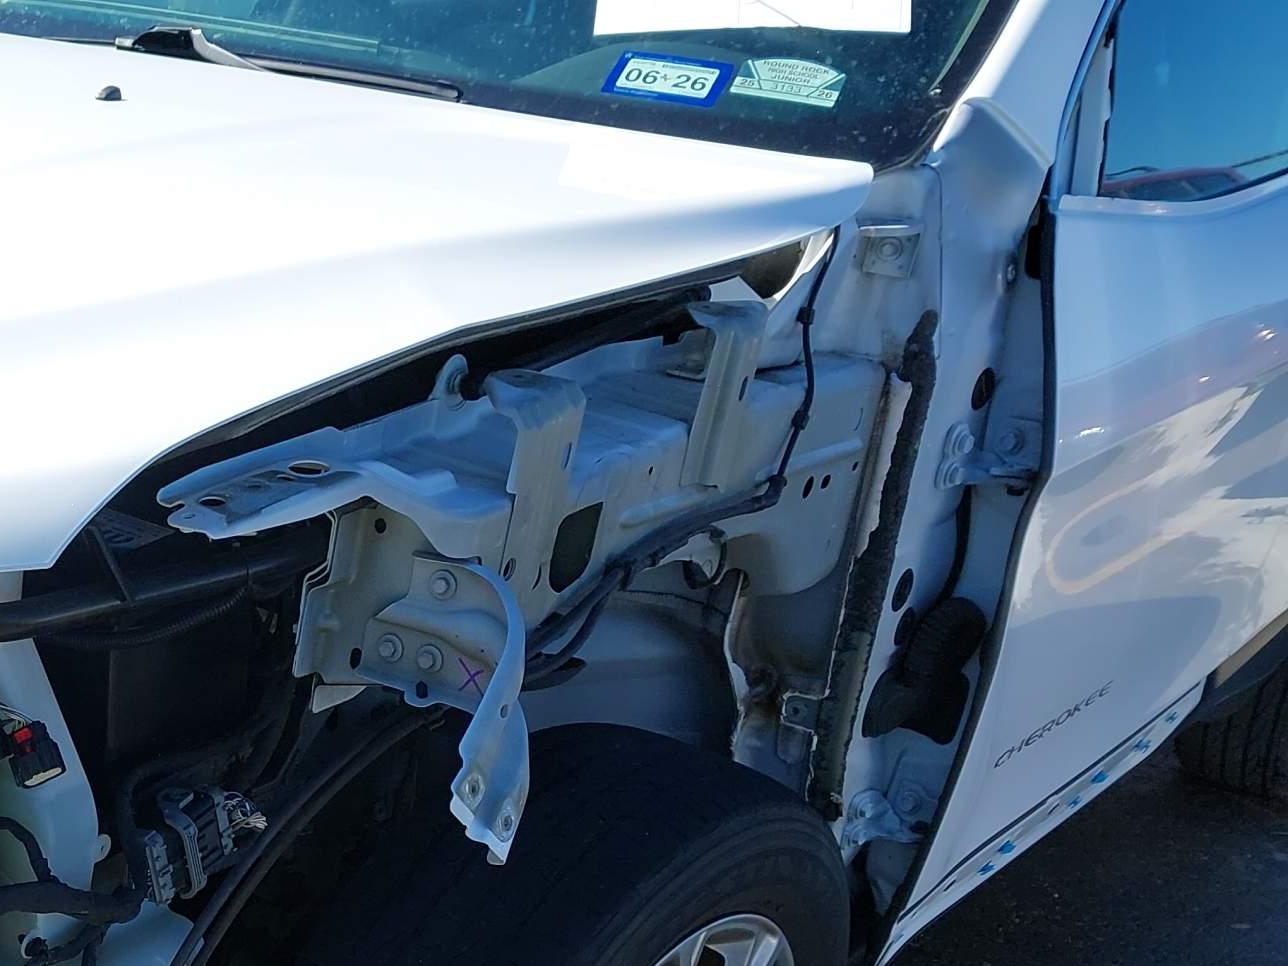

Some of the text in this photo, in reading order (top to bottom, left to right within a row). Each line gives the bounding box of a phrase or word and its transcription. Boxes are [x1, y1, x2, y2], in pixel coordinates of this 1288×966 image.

[624, 68, 710, 92] 06 26
[740, 78, 755, 87] 25
[771, 74, 811, 84] JUNIOR
[816, 90, 834, 99] 26
[993, 680, 1114, 769] CHEROKEE
